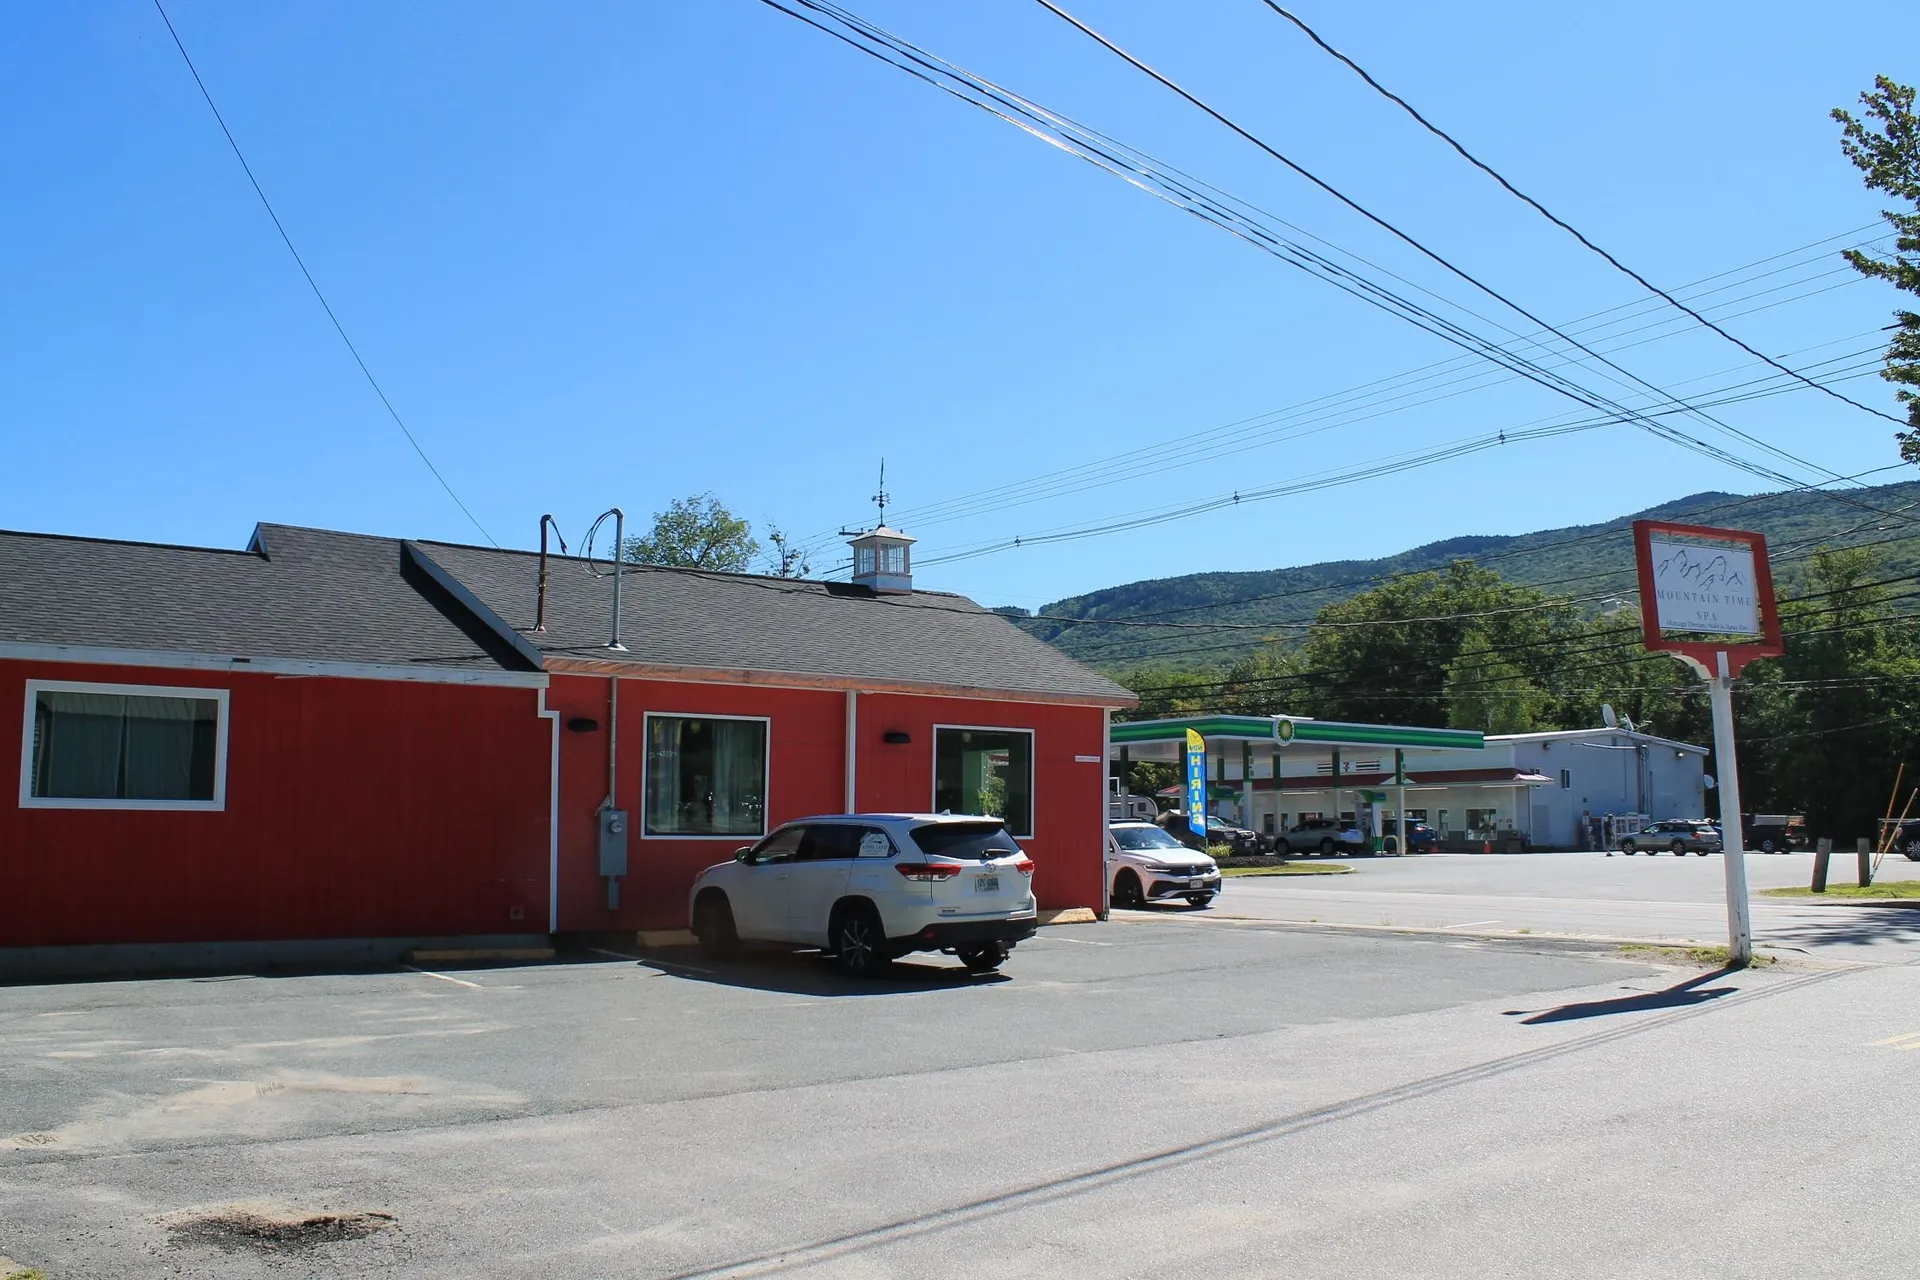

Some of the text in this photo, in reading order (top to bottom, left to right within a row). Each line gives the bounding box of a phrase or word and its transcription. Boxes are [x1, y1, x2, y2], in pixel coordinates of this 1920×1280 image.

[1657, 590, 1752, 606] MOUNTAIN TIME
[1696, 611, 1717, 621] SPA
